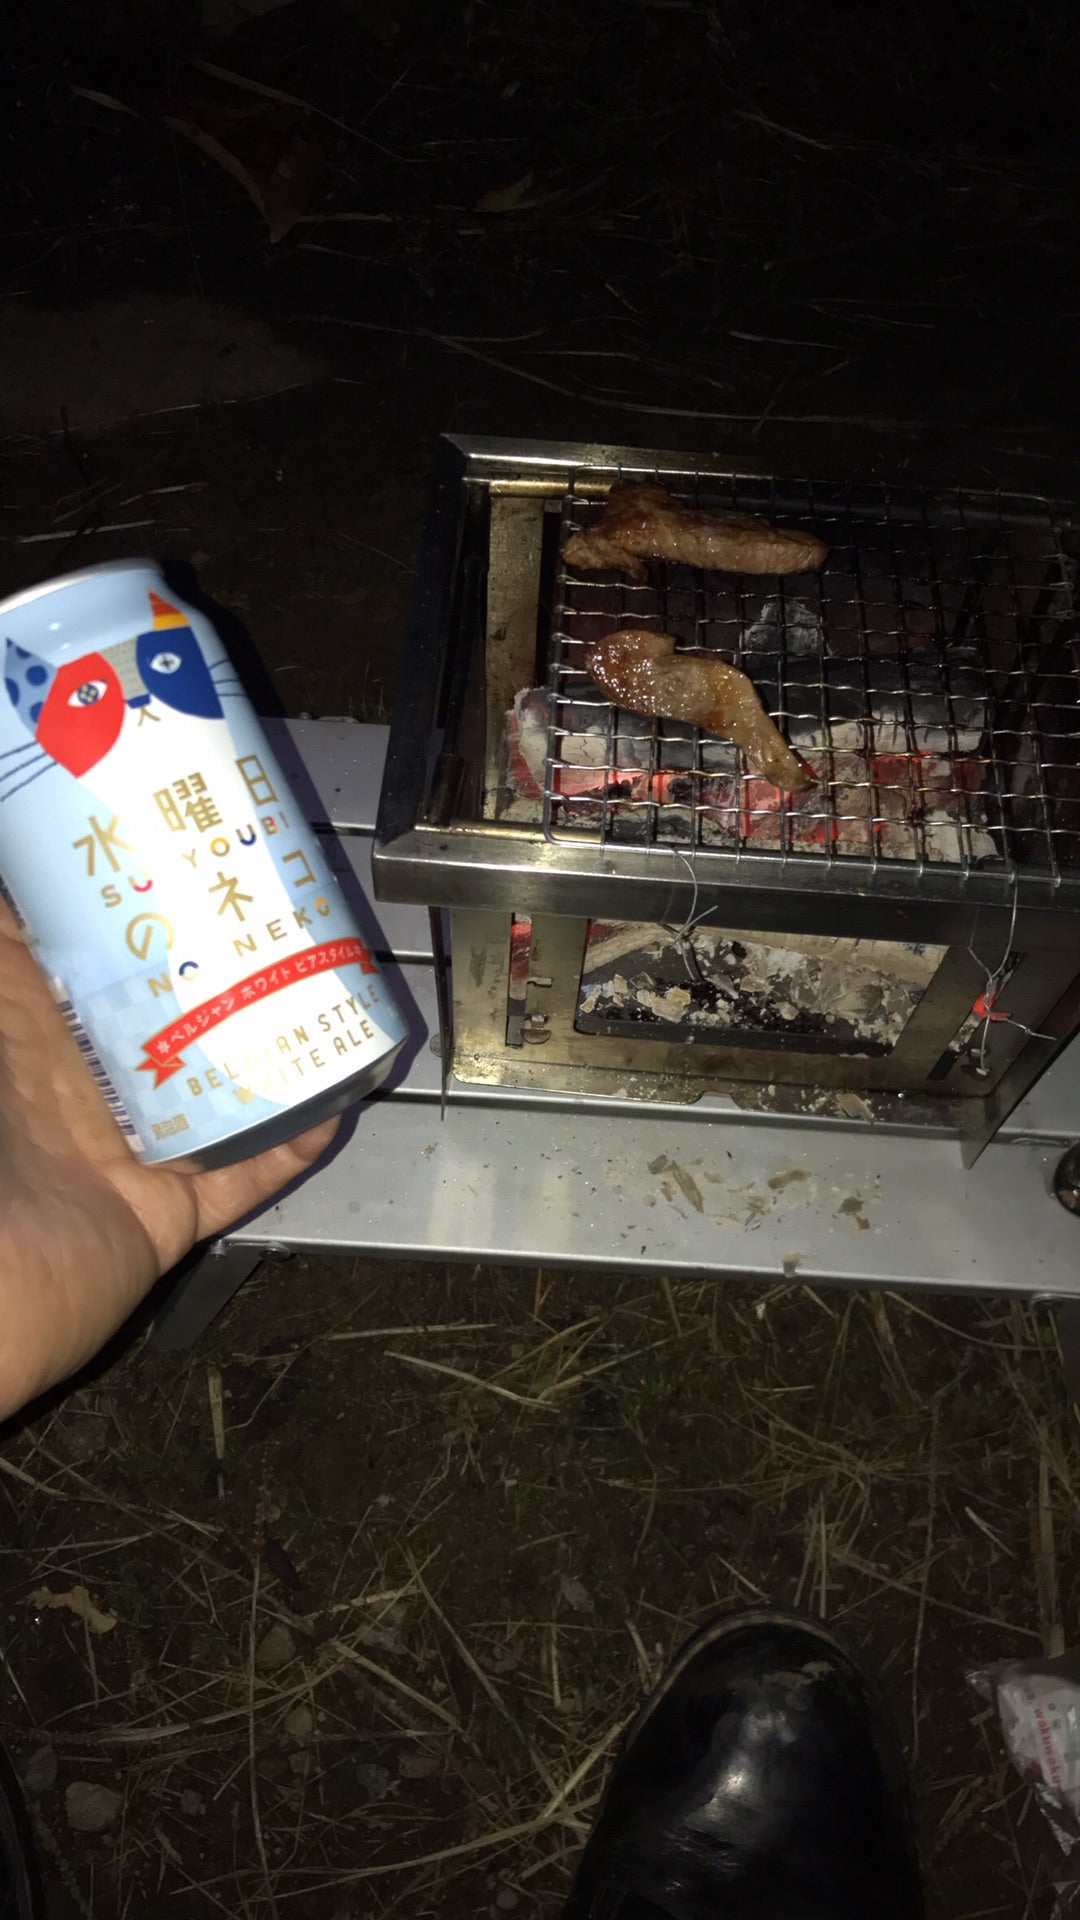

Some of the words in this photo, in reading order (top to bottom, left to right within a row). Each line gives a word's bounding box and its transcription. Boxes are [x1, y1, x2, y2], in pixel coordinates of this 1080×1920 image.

[73, 754, 278, 876] 水曜日
[125, 849, 317, 961] のネコ
[233, 896, 330, 957] NEKO
[170, 995, 236, 1043] ベルジャン
[240, 966, 292, 998] ホワイト
[317, 984, 380, 1033] STYLE
[332, 1019, 375, 1056] ALE
